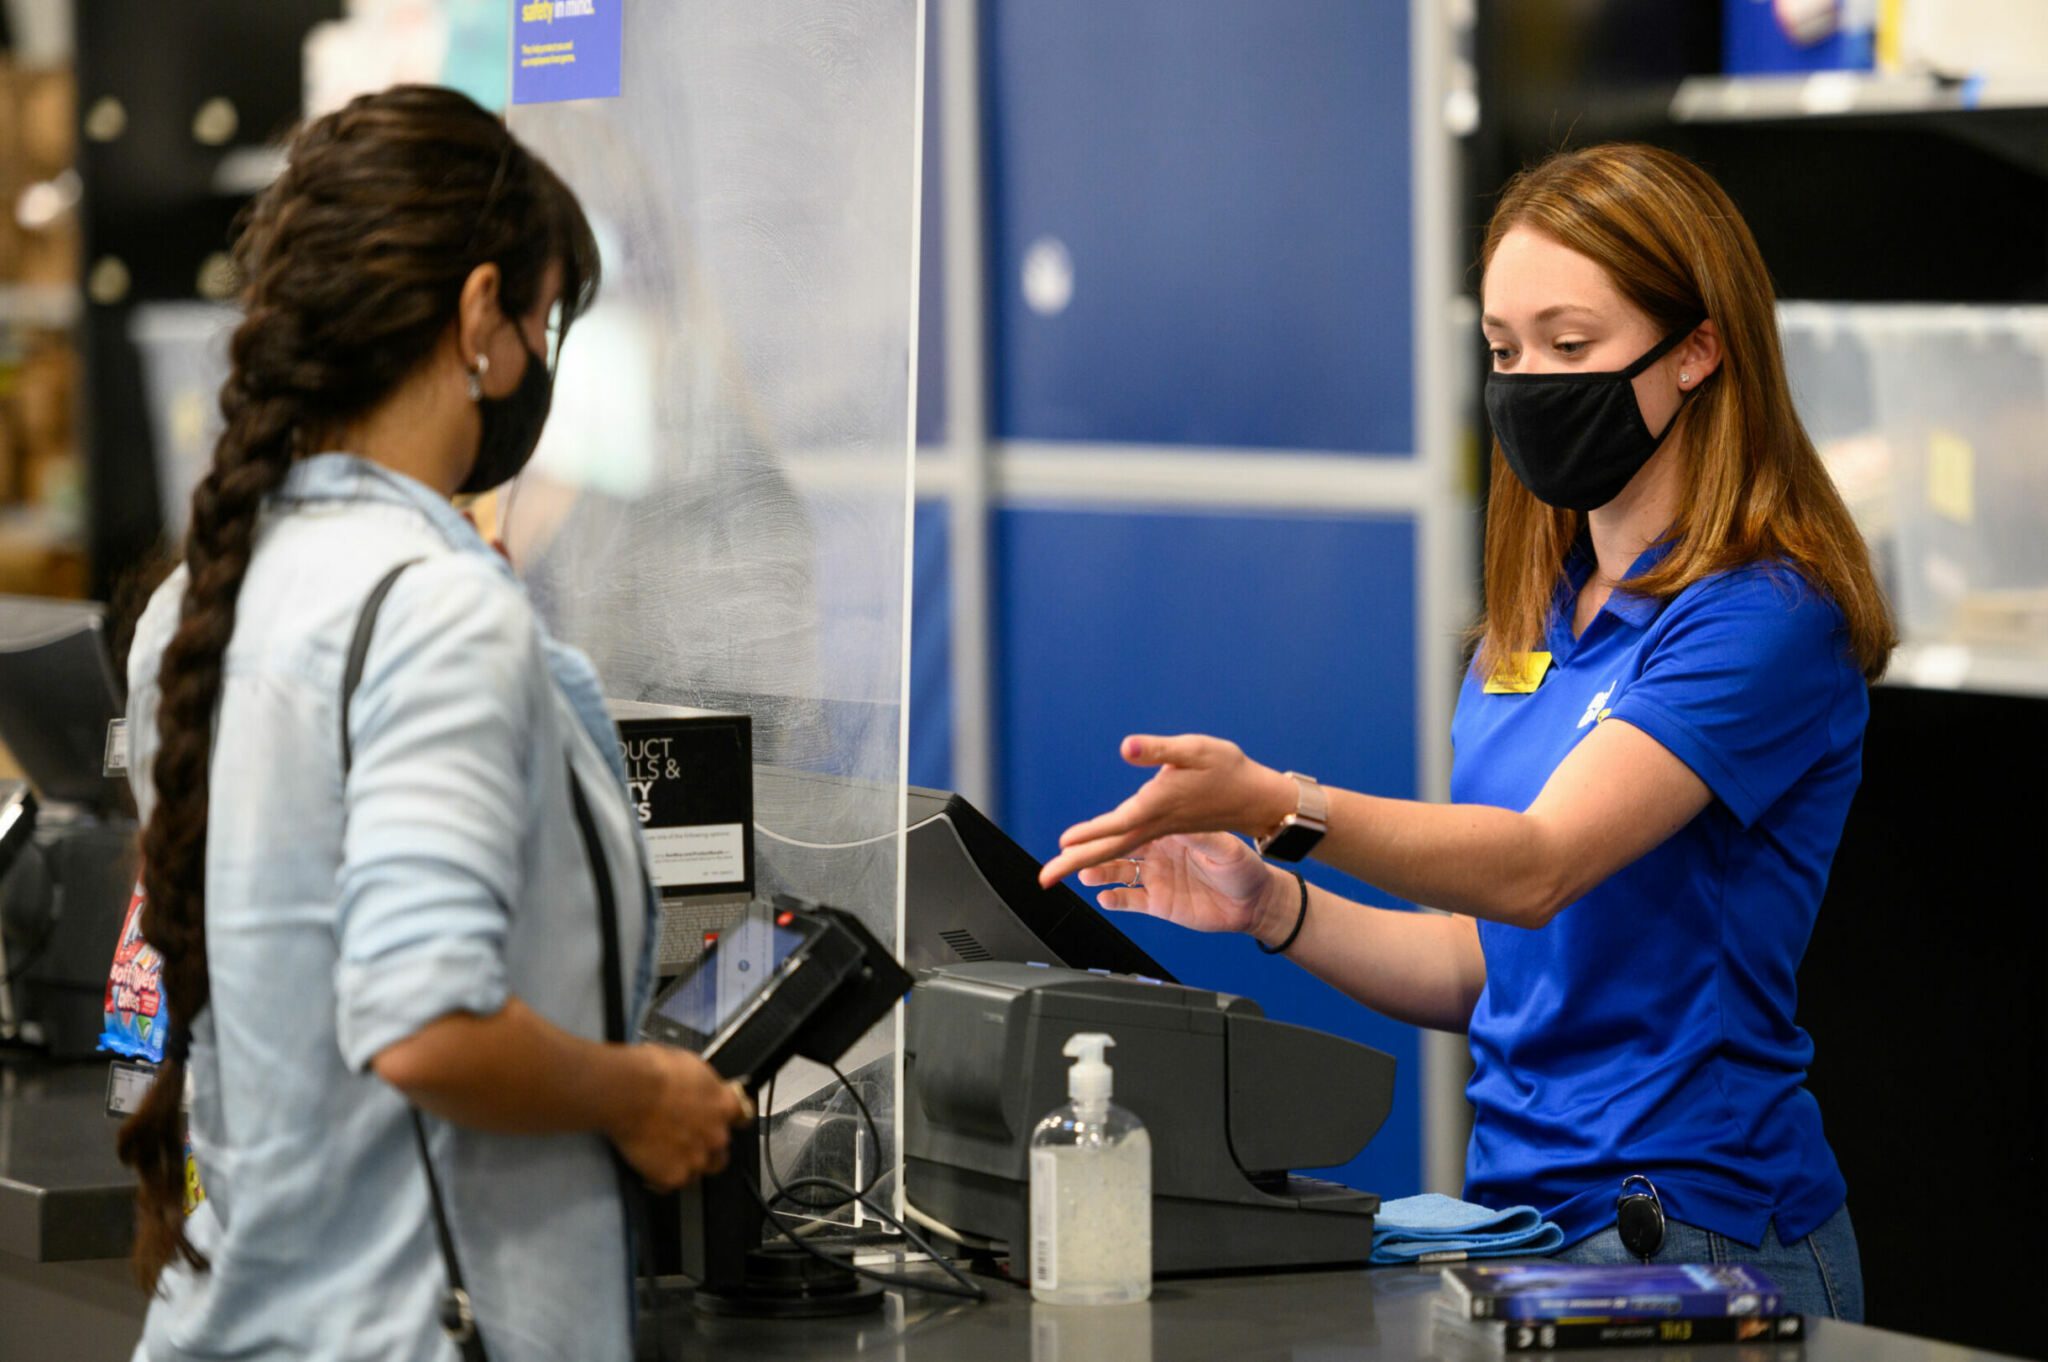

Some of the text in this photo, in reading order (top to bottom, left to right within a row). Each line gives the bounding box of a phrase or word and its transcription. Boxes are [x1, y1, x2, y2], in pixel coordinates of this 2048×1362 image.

[522, 0, 554, 24] safety
[554, 1, 565, 18] in
[665, 758, 681, 780] &
